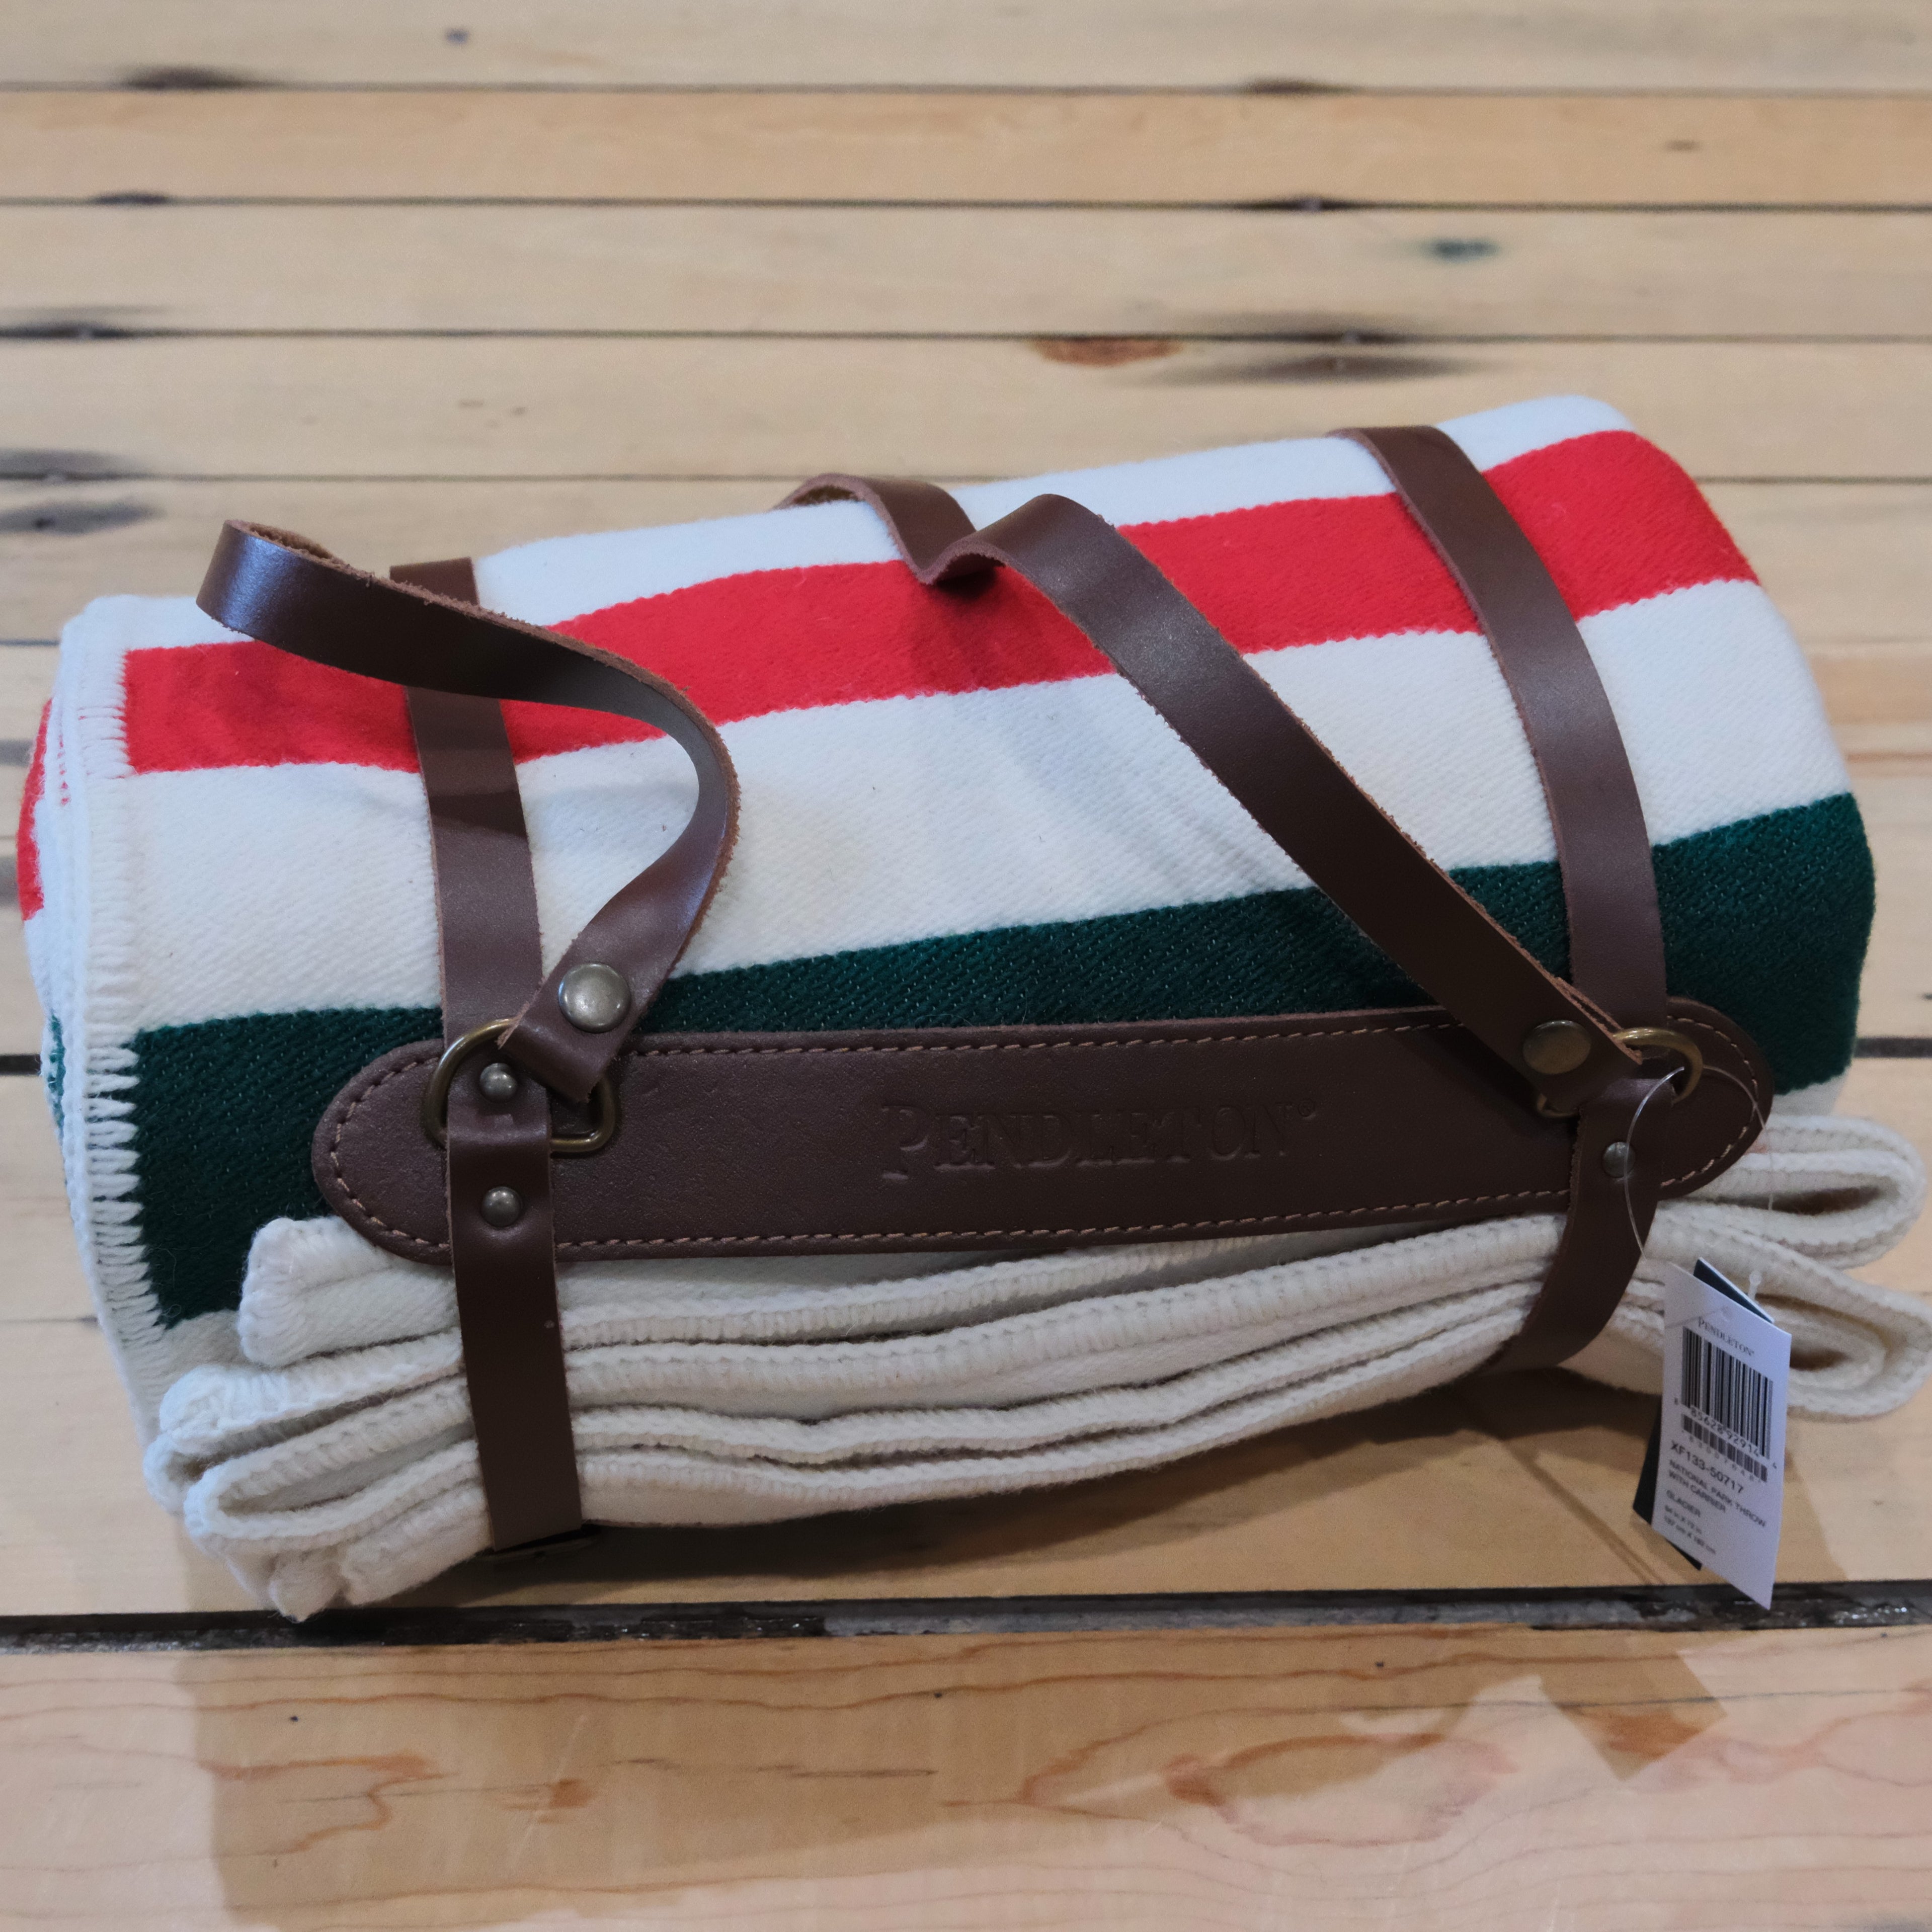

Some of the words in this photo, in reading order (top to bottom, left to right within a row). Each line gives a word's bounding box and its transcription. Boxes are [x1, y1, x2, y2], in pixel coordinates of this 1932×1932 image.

[1669, 1459, 1707, 1490] NATIONAL
[1670, 1440, 1744, 1494] XF133-50717
[1666, 1489, 1701, 1517] GLACIER
[1669, 1470, 1689, 1487] WITH
[1690, 1484, 1726, 1513] CARRIER
